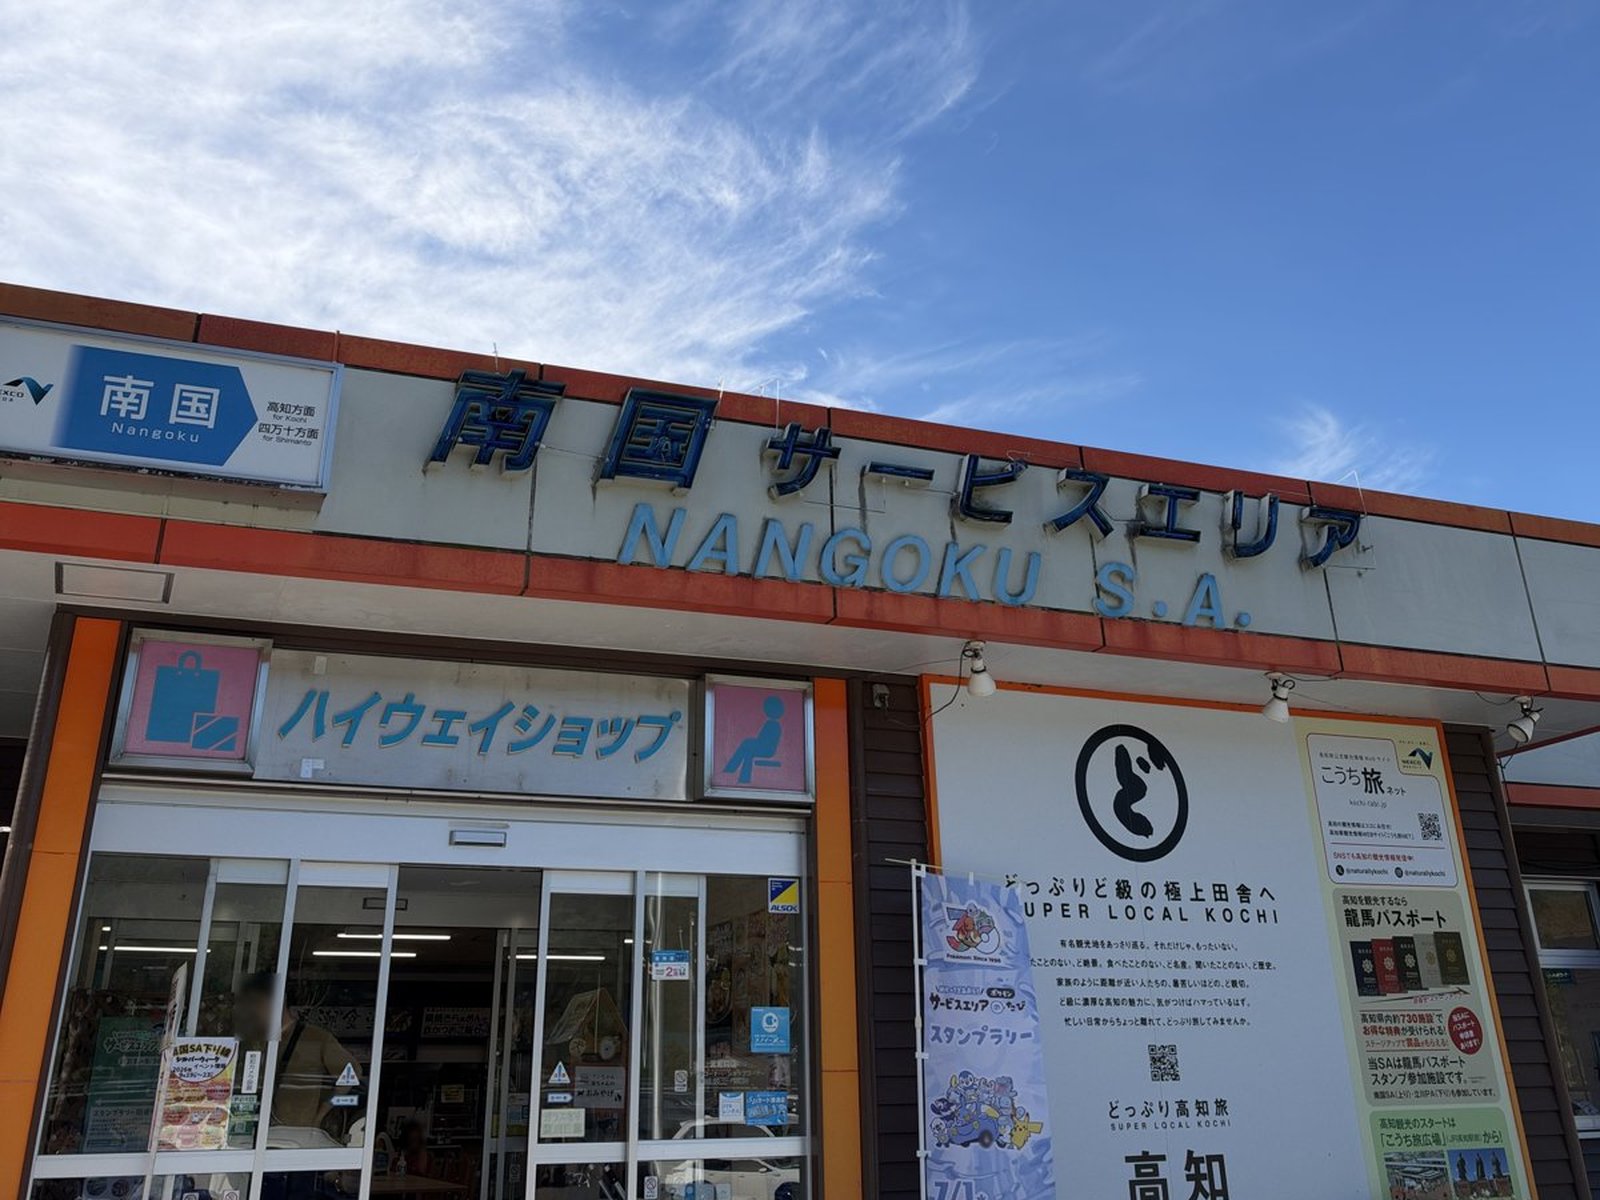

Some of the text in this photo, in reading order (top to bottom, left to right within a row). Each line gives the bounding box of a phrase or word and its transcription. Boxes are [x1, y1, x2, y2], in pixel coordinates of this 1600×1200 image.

[100, 375, 221, 429] 南国
[266, 402, 317, 417] 高知方面
[285, 415, 308, 423] Kochi
[111, 422, 200, 444] Nangoku
[258, 422, 320, 440] 四万十方面
[617, 502, 1253, 629] NANGOKU S.A.
[277, 688, 682, 763] ハイウェイショップ
[771, 904, 798, 912] ALSOK
[1024, 903, 1279, 924] UPER LOCAL KOCHI
[1344, 908, 1447, 928] 龍馬パスポート
[931, 1025, 1033, 1046] スタンプラリー
[1108, 1098, 1229, 1119] どっぷり高知旅
[1111, 1118, 1231, 1131] SUPER LOCAL KOCHI
[1124, 1149, 1231, 1200] 高知
